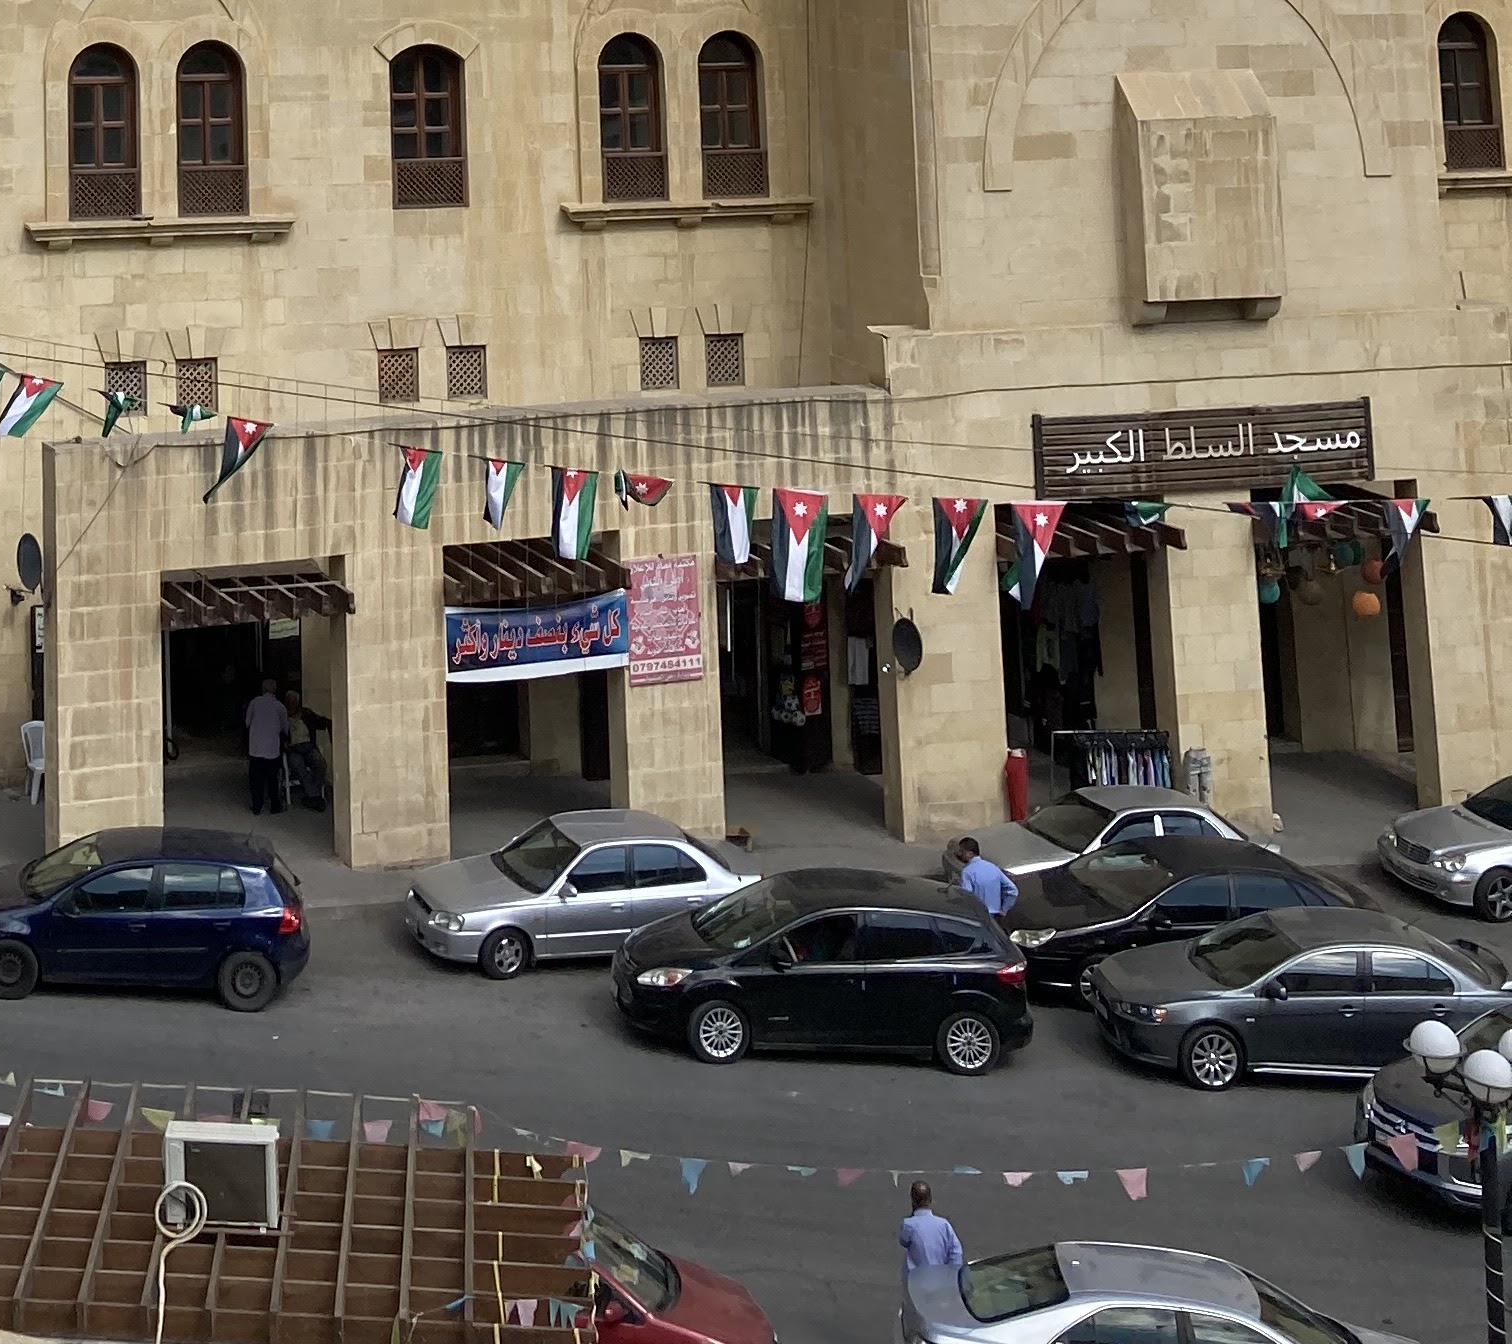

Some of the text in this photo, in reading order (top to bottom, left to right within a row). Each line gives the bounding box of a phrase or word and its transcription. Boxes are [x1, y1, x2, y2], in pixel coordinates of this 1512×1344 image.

[1065, 422, 1361, 474] مسجد السلط الكبير
[489, 618, 524, 661] دينار
[525, 613, 569, 655] بنصف
[570, 604, 601, 655] شيء
[602, 608, 622, 647] كل
